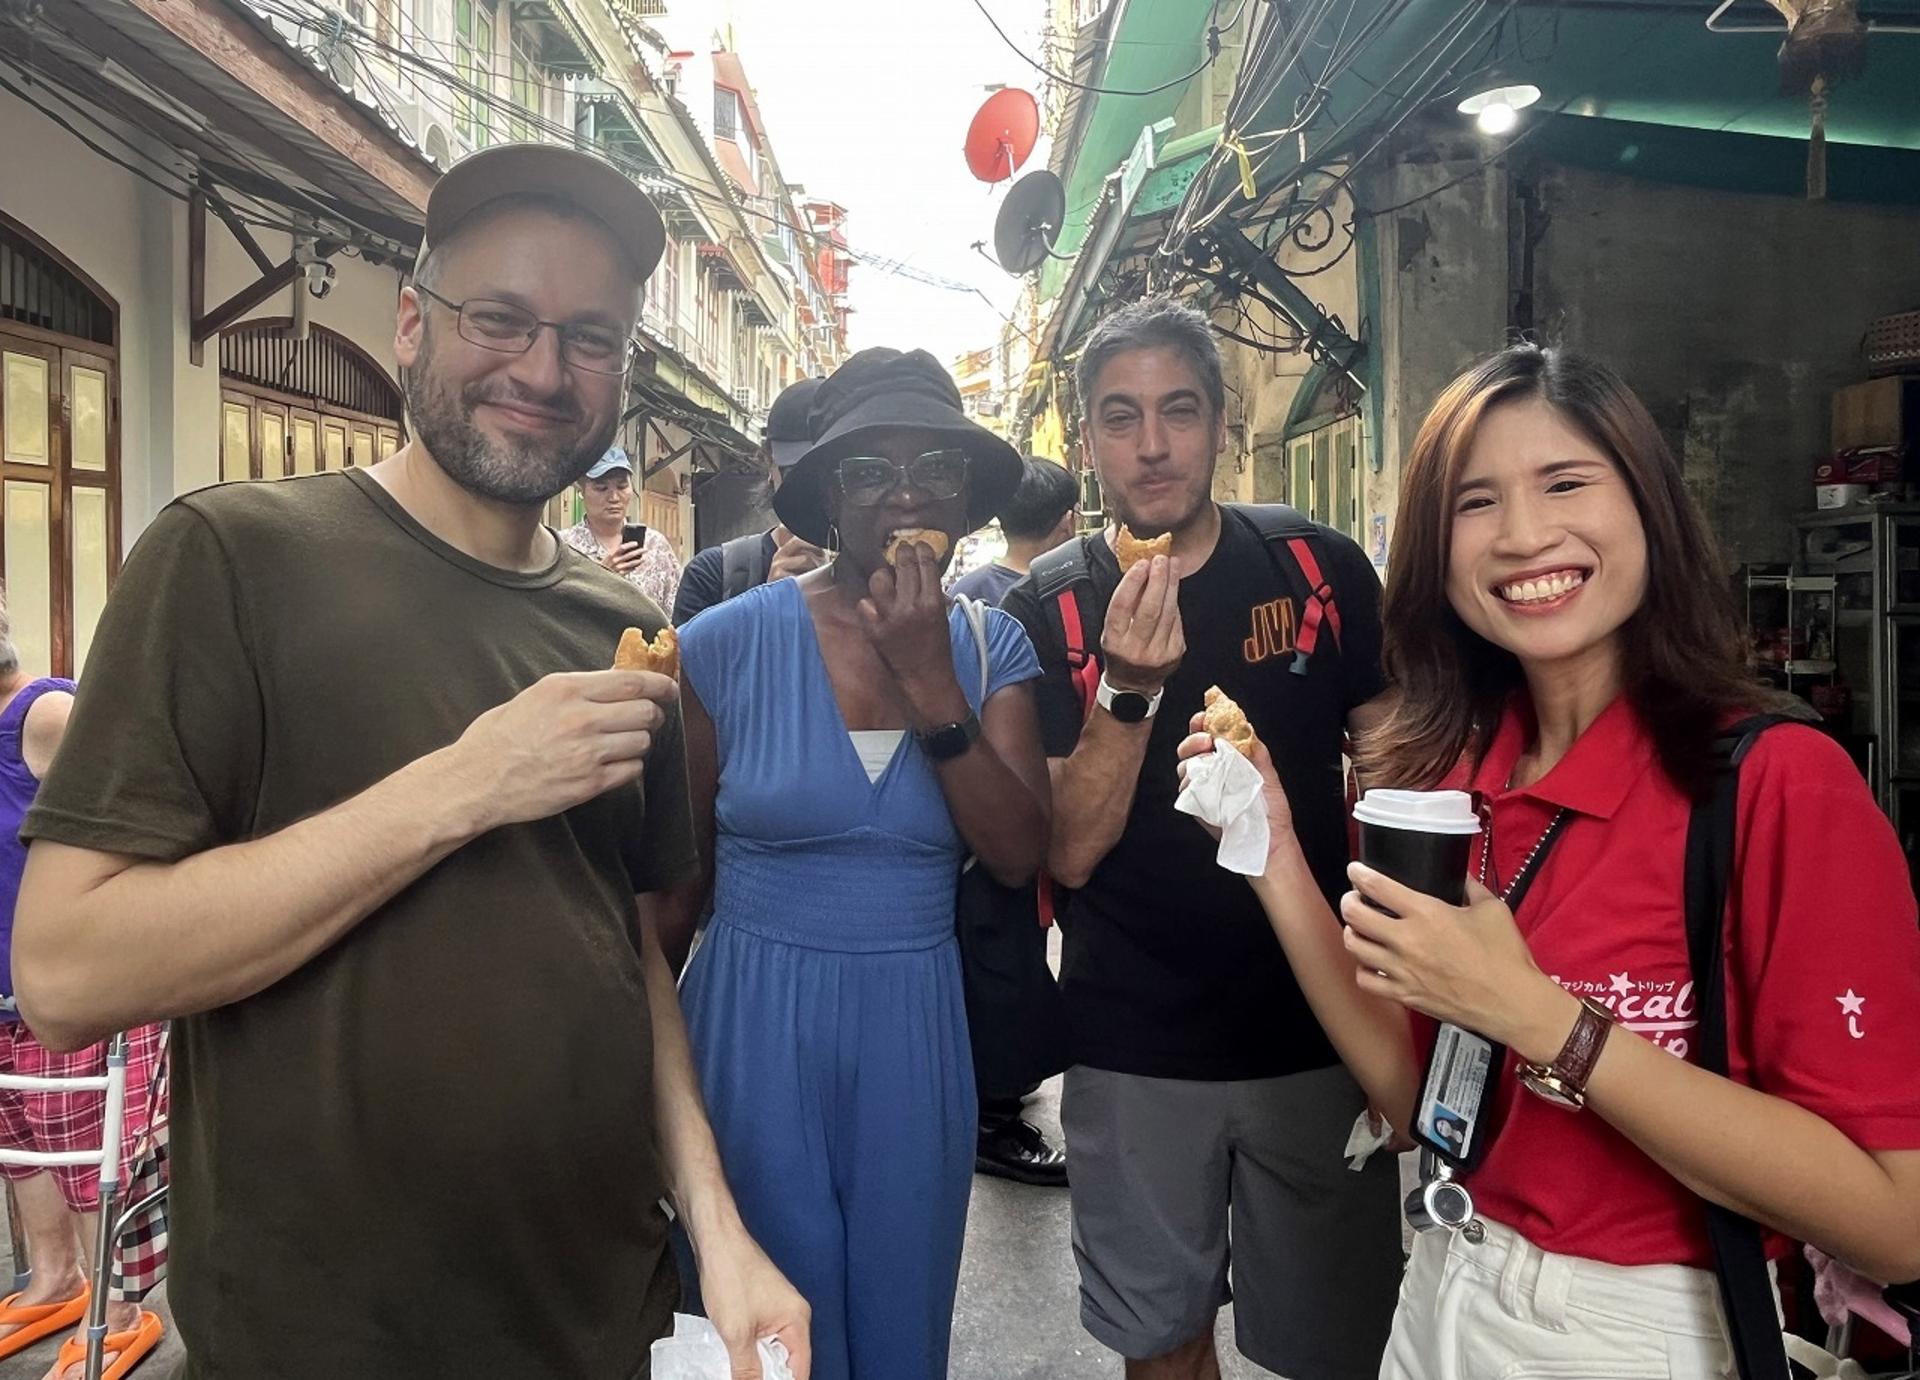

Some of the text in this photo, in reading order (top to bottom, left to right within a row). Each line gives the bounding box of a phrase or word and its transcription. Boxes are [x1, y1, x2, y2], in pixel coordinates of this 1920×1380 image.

[1559, 980, 1676, 993] マジカル トリップ
